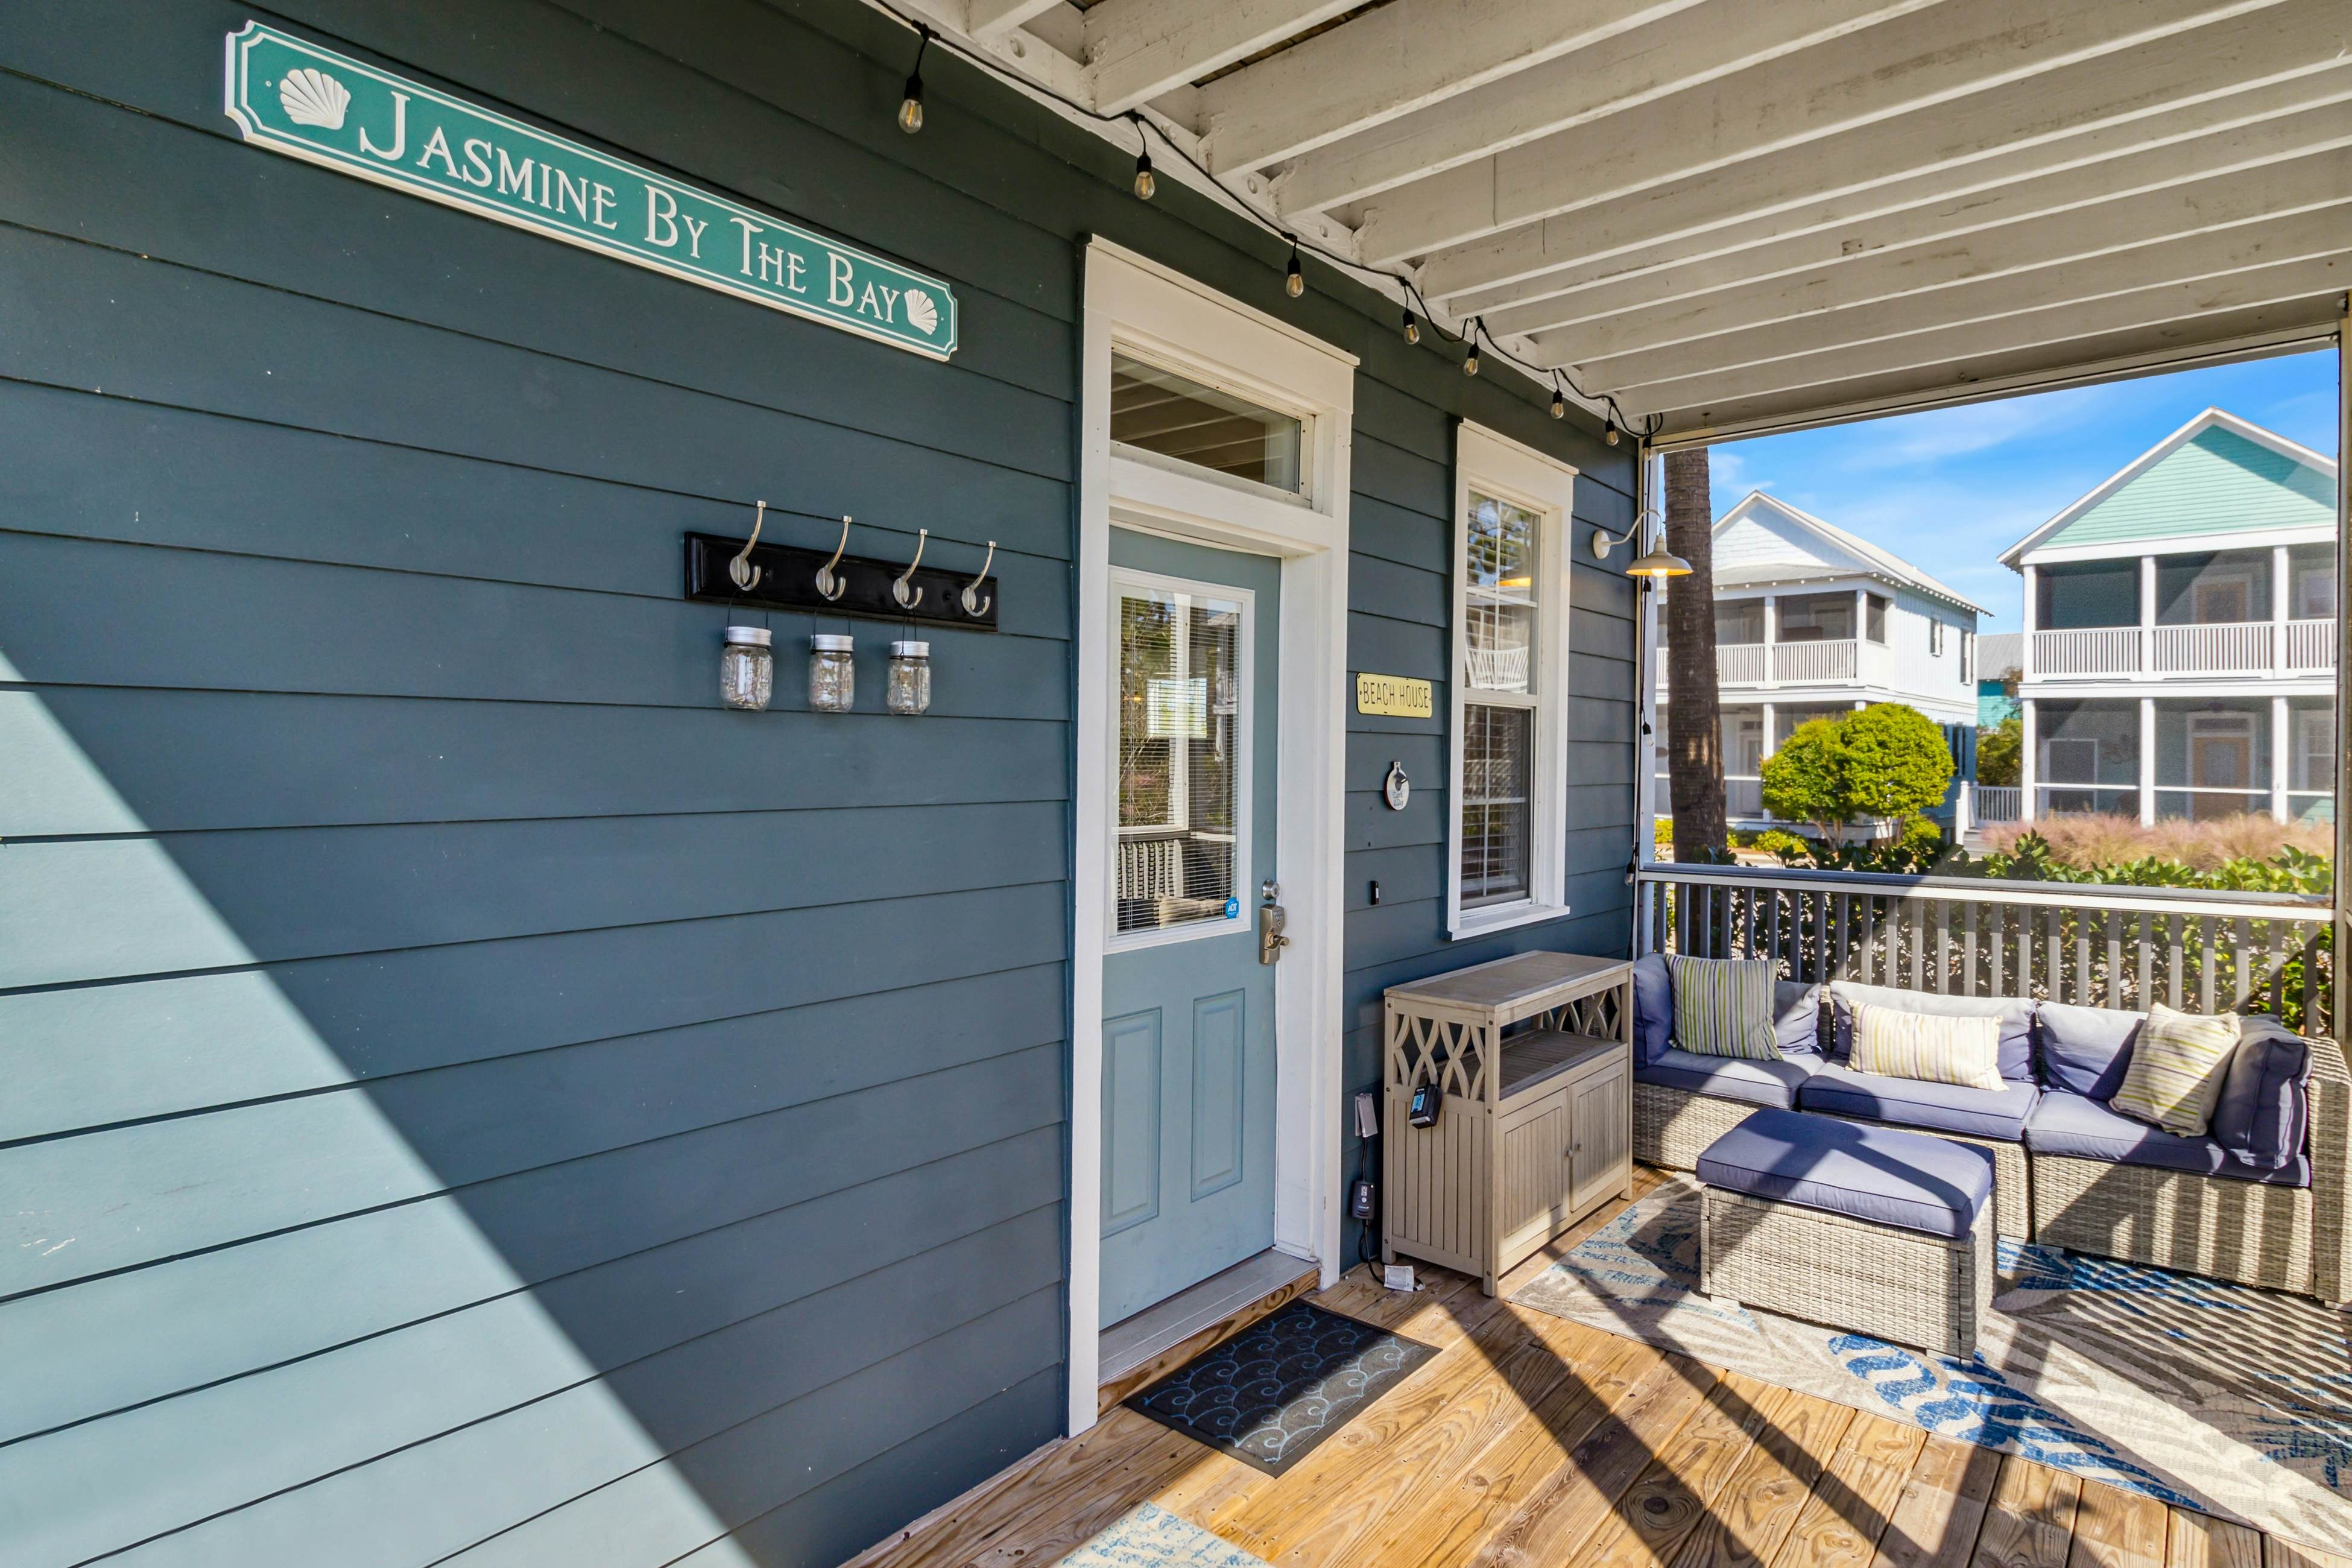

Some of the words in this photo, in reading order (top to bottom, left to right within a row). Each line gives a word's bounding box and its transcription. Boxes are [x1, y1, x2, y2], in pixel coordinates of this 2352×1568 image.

[360, 91, 617, 230] JASMINE
[645, 185, 709, 259] BY
[730, 217, 806, 294] THE
[827, 251, 900, 324] BAY
[1363, 682, 1395, 706] BEACH
[1400, 685, 1429, 708] HOUSE
[1227, 903, 1238, 912] ADT
